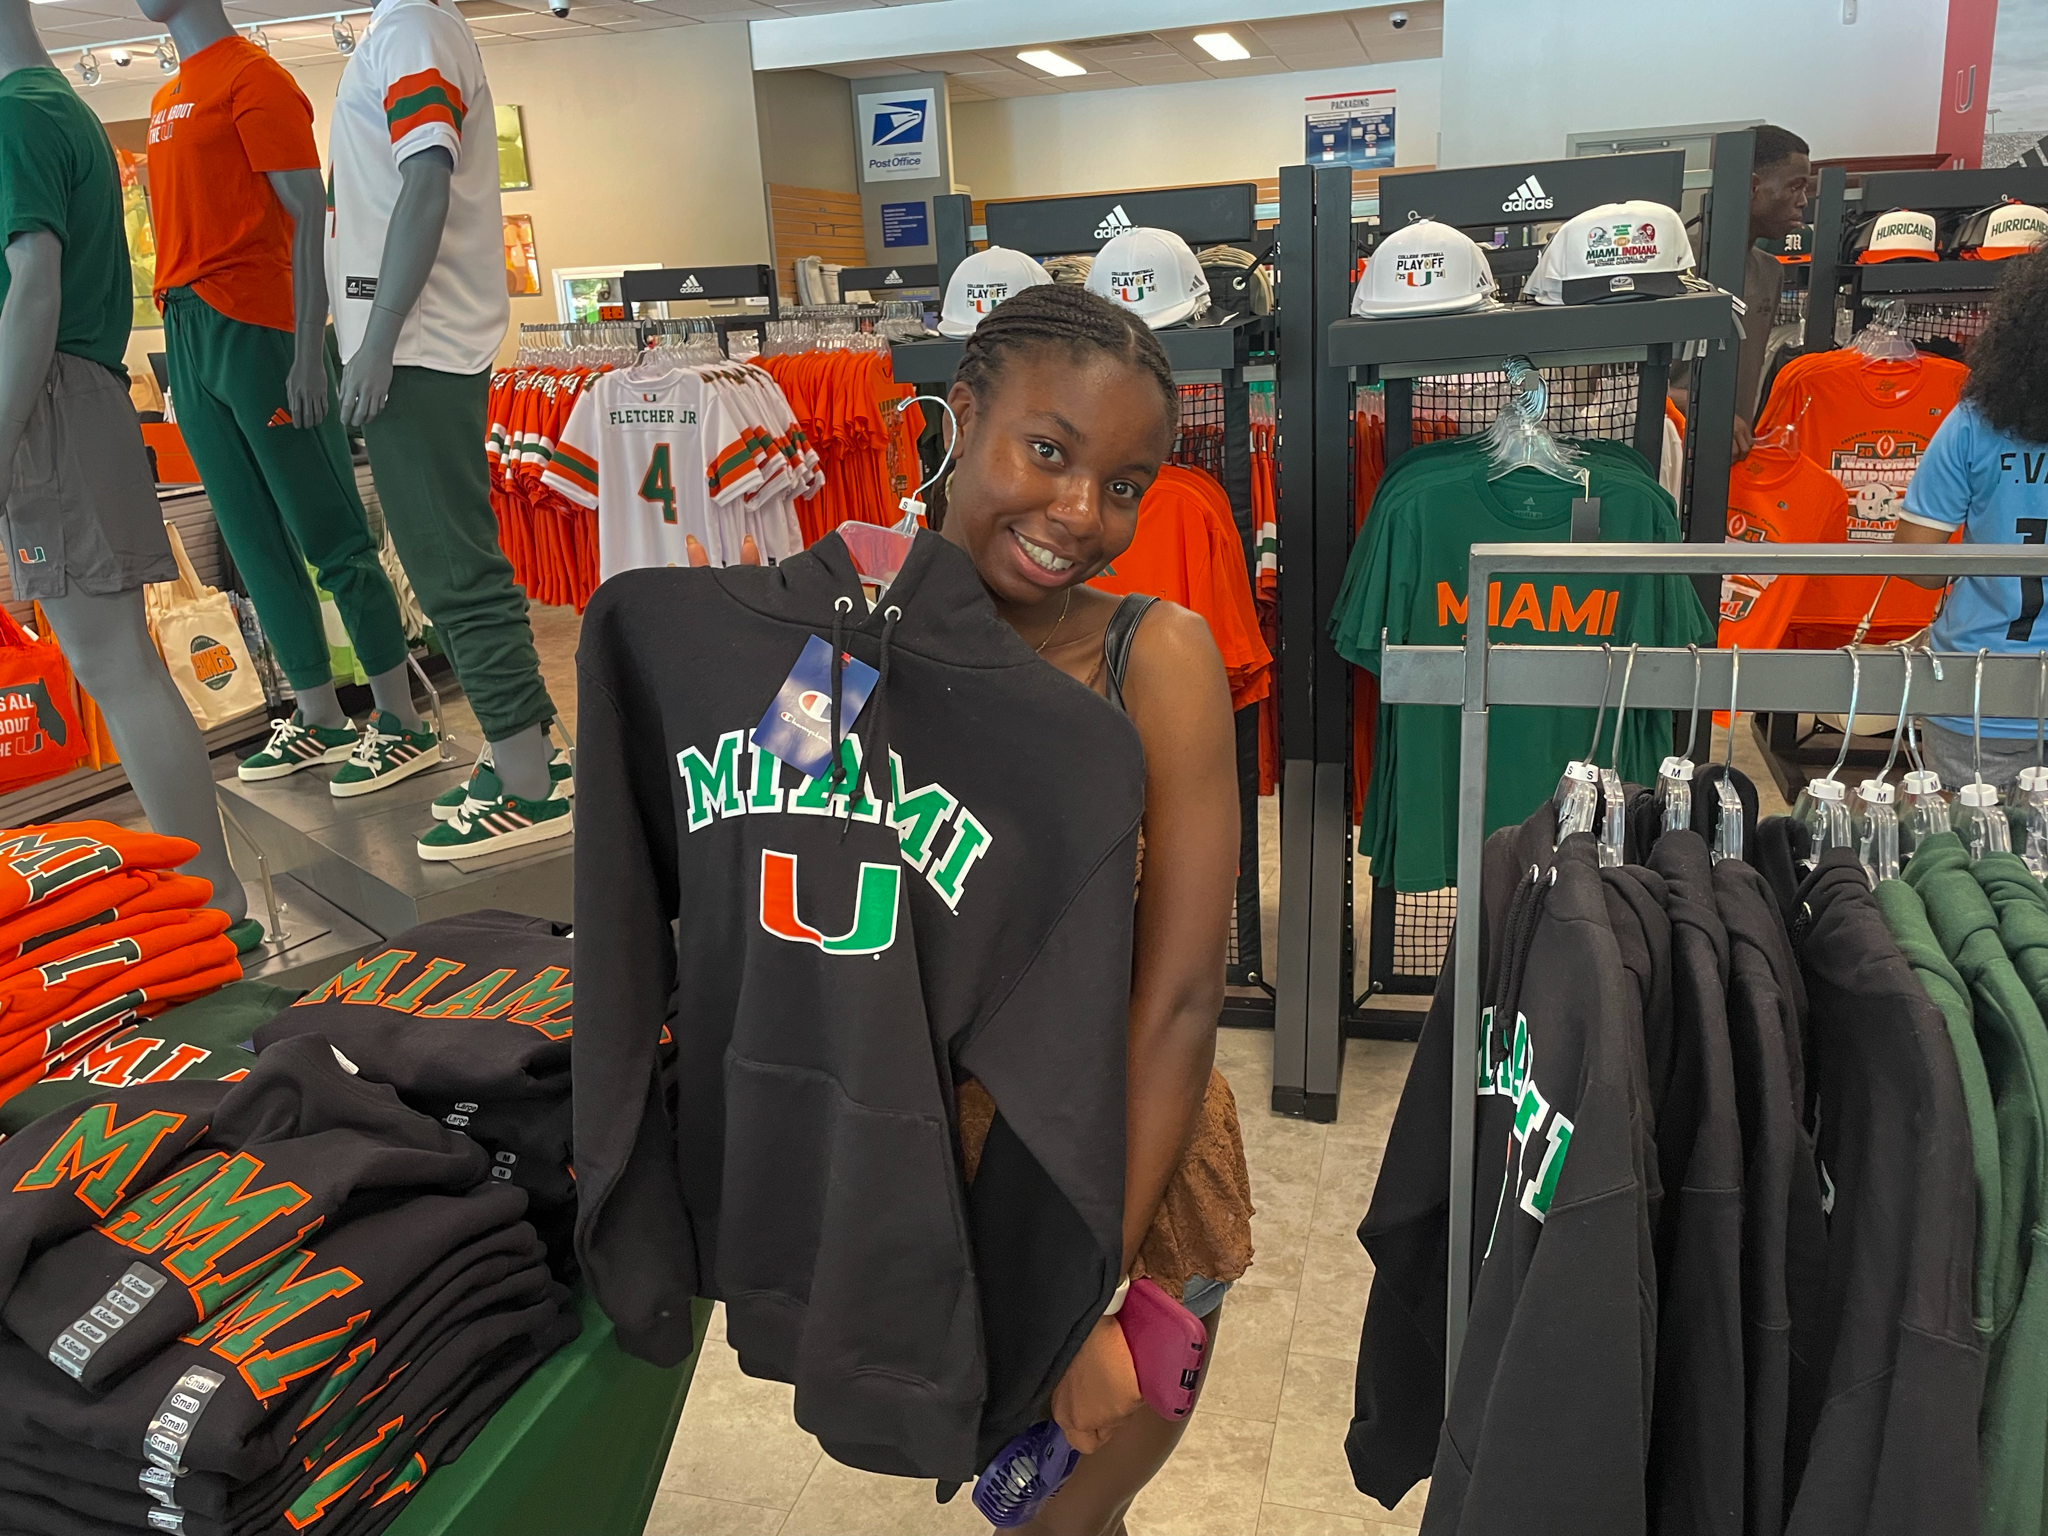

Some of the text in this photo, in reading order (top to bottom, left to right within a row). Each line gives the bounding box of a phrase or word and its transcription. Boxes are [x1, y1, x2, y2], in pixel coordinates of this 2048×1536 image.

[1955, 65, 1977, 114] U
[167, 103, 195, 121] ABOUT
[1331, 98, 1370, 111] PACKAGING
[161, 122, 173, 141] U
[868, 156, 921, 169] Post Office
[1501, 196, 1554, 213] adidas
[1875, 222, 1934, 242] HURRICANES
[1784, 233, 1803, 252] M
[1586, 244, 1658, 260] MIAMI INDIANA
[1131, 268, 1154, 276] FOOTBALL
[1396, 257, 1445, 271] PLAYOFF
[1111, 273, 1155, 287] PLAYOFF
[1407, 271, 1432, 287] U
[966, 287, 1008, 299] PLAYOFF
[1121, 286, 1145, 303] U
[642, 393, 657, 403] U
[609, 409, 697, 425] FLETCHER JR
[1858, 447, 1873, 457] 20
[637, 442, 679, 526] 4
[902, 501, 909, 510] S
[18, 546, 46, 565] U
[1436, 580, 1620, 637] MIAMI
[190, 644, 238, 683] CANES
[9, 692, 35, 711] ALL
[780, 711, 829, 744] Champion
[15, 731, 43, 756] U
[1567, 765, 1594, 780] S S
[1670, 767, 1681, 779] M
[1812, 786, 1818, 795] L
[1930, 780, 1939, 791] M
[1876, 792, 1887, 802] M
[676, 727, 994, 912] MIAMI
[760, 848, 902, 956] U
[448, 1114, 469, 1126] Large
[502, 1153, 511, 1163] M
[498, 1169, 507, 1178] M
[124, 1275, 152, 1296] X-Small
[110, 1291, 137, 1312] X-Small
[93, 1307, 121, 1326] X-Small
[76, 1322, 103, 1341] X-Small
[60, 1336, 88, 1357] X-Small
[185, 1375, 212, 1393] Small
[172, 1394, 200, 1413] Small
[160, 1414, 188, 1434] Small
[151, 1435, 178, 1454] Small
[146, 1468, 171, 1483] Small
